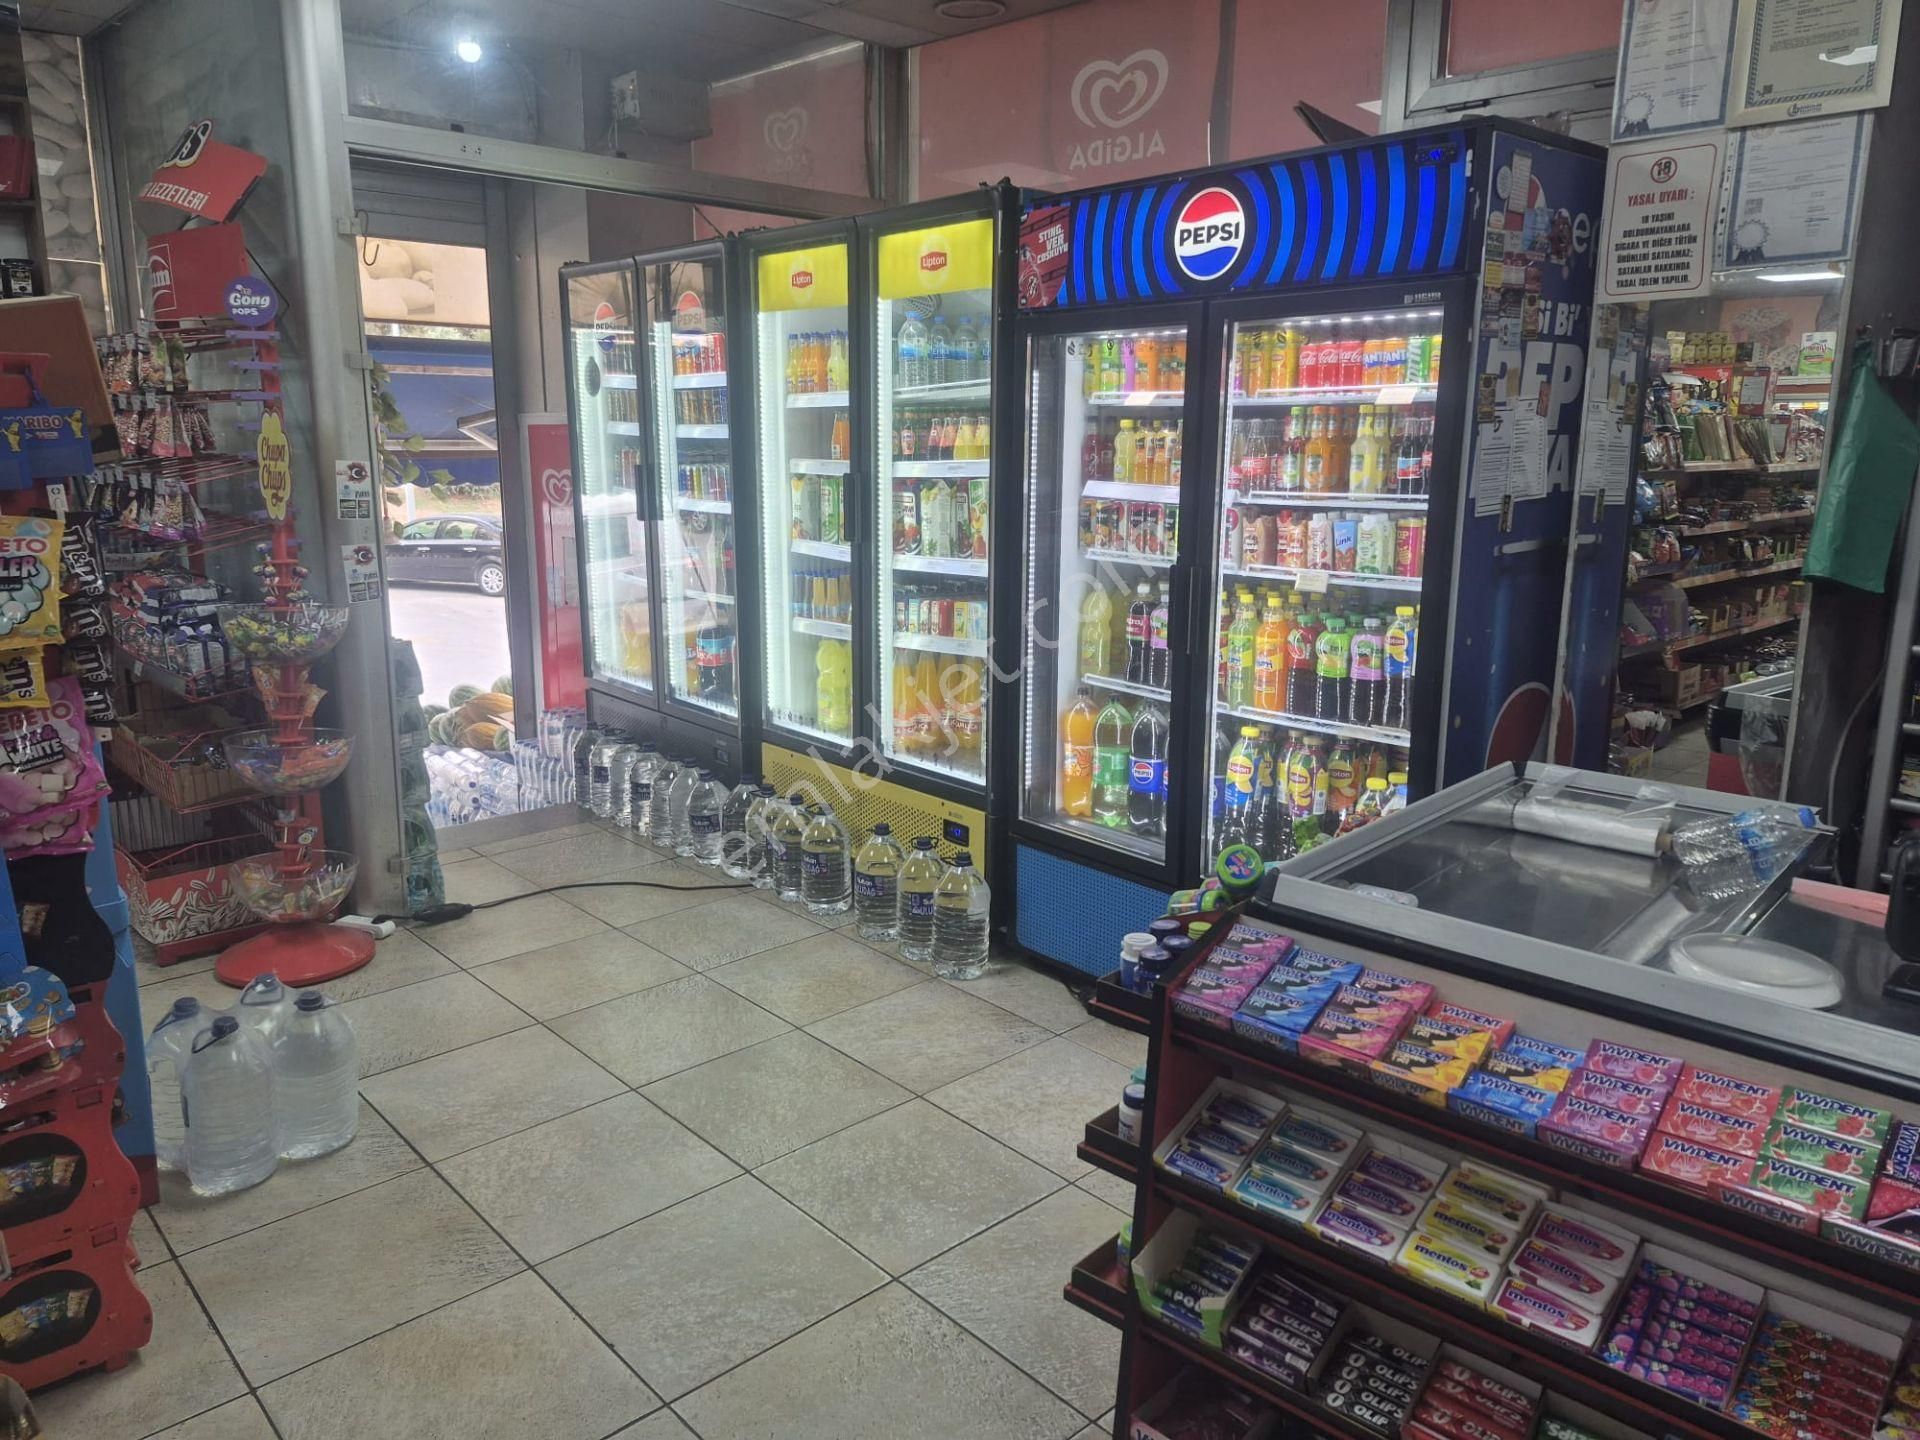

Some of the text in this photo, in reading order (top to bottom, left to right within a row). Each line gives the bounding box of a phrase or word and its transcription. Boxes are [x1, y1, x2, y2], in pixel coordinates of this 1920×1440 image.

[1628, 193, 1655, 207] YASAL
[1659, 188, 1688, 203] UYARI
[1045, 233, 1065, 251] VER
[1179, 221, 1240, 247] PEPSI
[922, 255, 946, 270] Lipton
[793, 273, 812, 287] Lipton
[232, 307, 259, 317] POPS
[261, 436, 286, 469] Chupa
[262, 463, 287, 495] Chups
[1174, 1151, 1218, 1177] mentos
[1246, 1176, 1293, 1204] mentos
[1454, 1179, 1506, 1205] mentos
[1326, 1209, 1378, 1239] mentos
[1434, 1210, 1487, 1238] mentos
[1545, 1222, 1602, 1250] mentos
[1414, 1243, 1470, 1273] mentos
[1525, 1250, 1585, 1283] mentos
[1507, 1287, 1569, 1320] mentos
